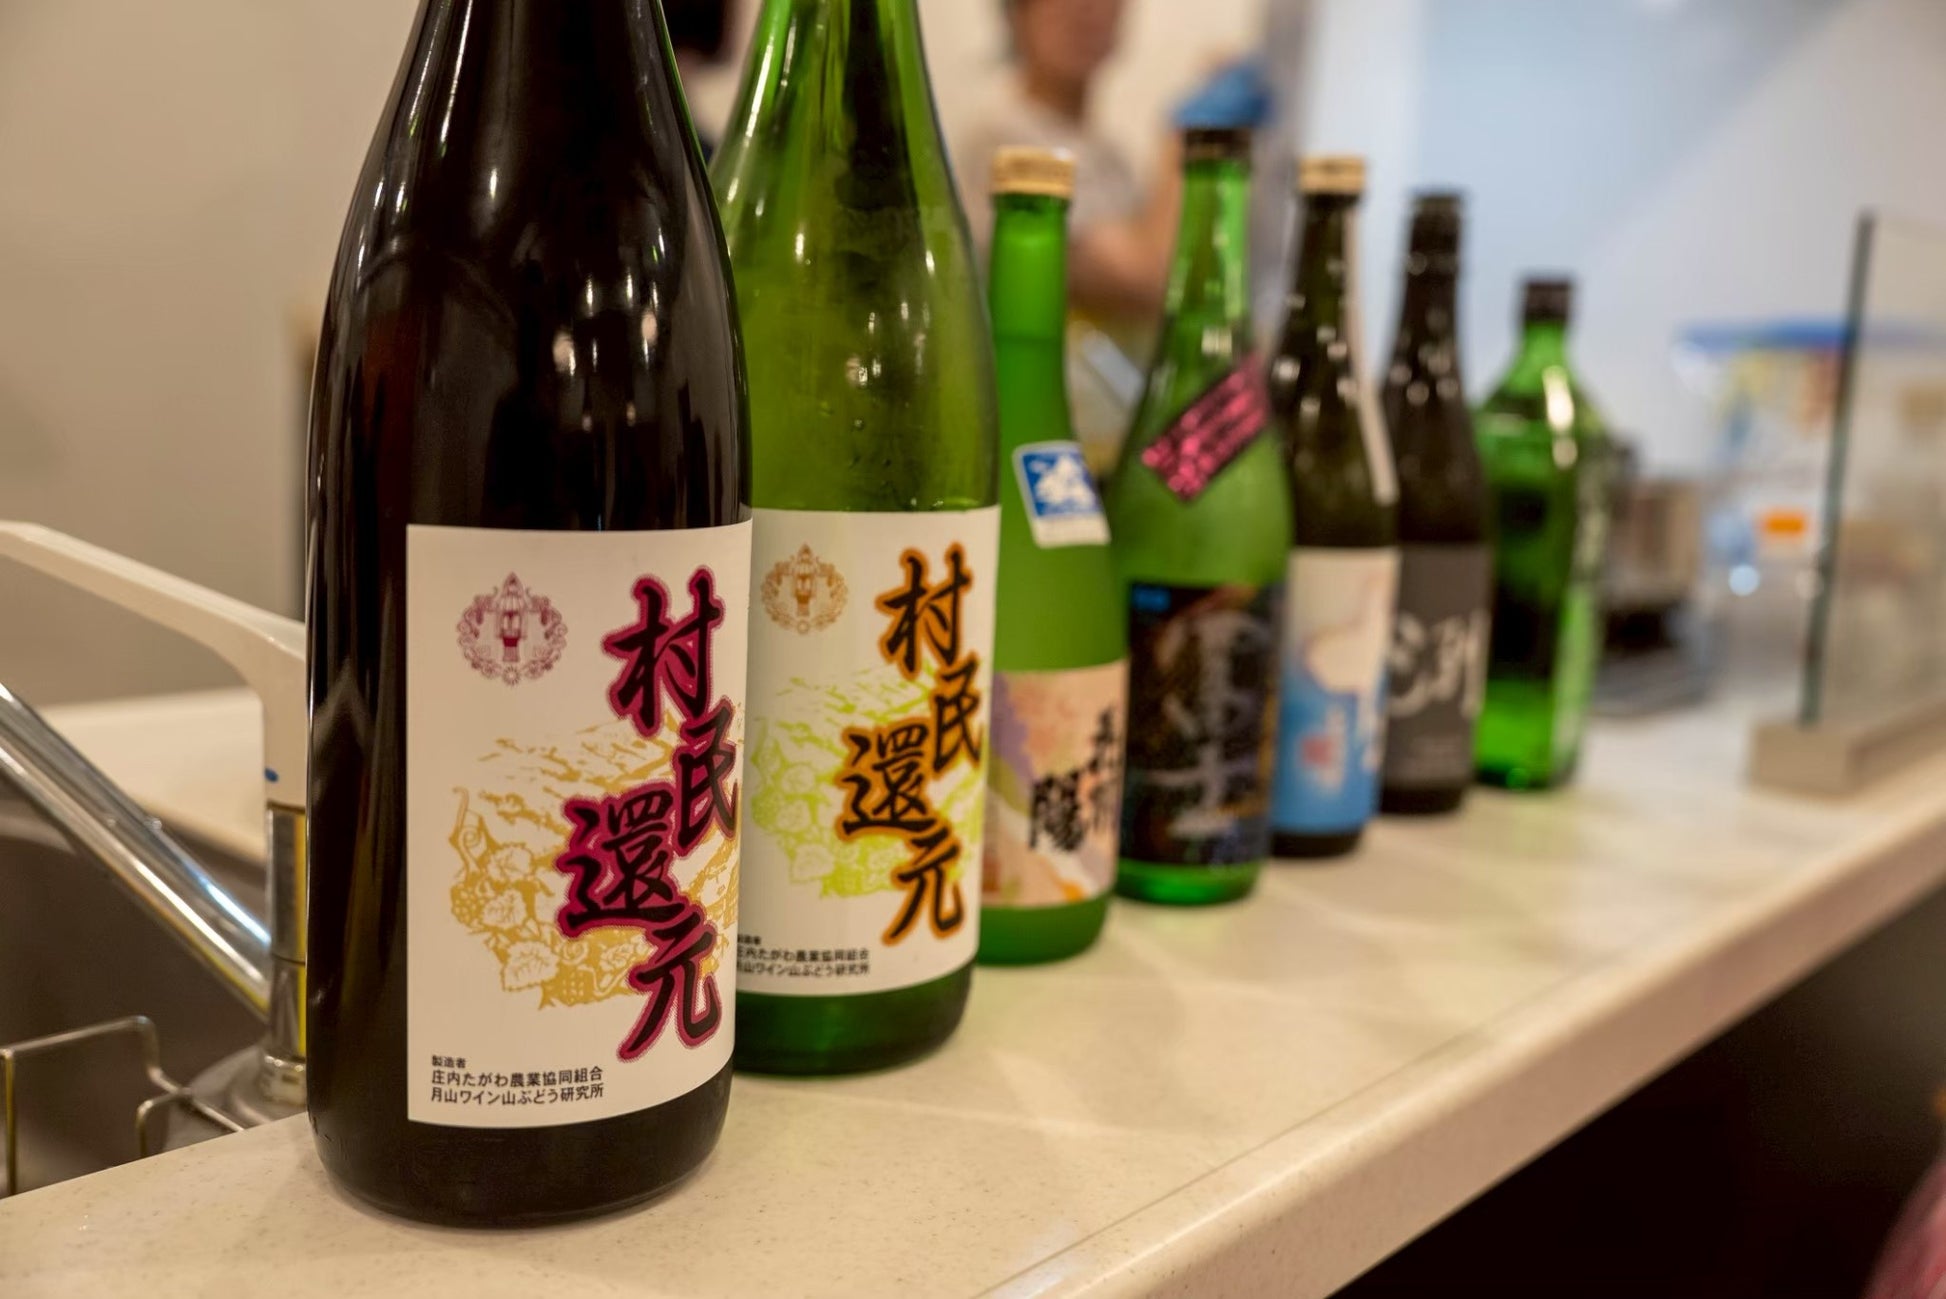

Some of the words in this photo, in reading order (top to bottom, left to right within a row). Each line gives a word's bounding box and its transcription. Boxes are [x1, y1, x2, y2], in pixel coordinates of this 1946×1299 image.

[836, 542, 983, 945] 村民還元
[557, 567, 739, 1062] 村民還元
[432, 1055, 466, 1068] 製造者
[432, 1066, 603, 1087] 庄内たがわ農業協同組合
[431, 1082, 604, 1105] 月山ワイン山ぶどう研究所
